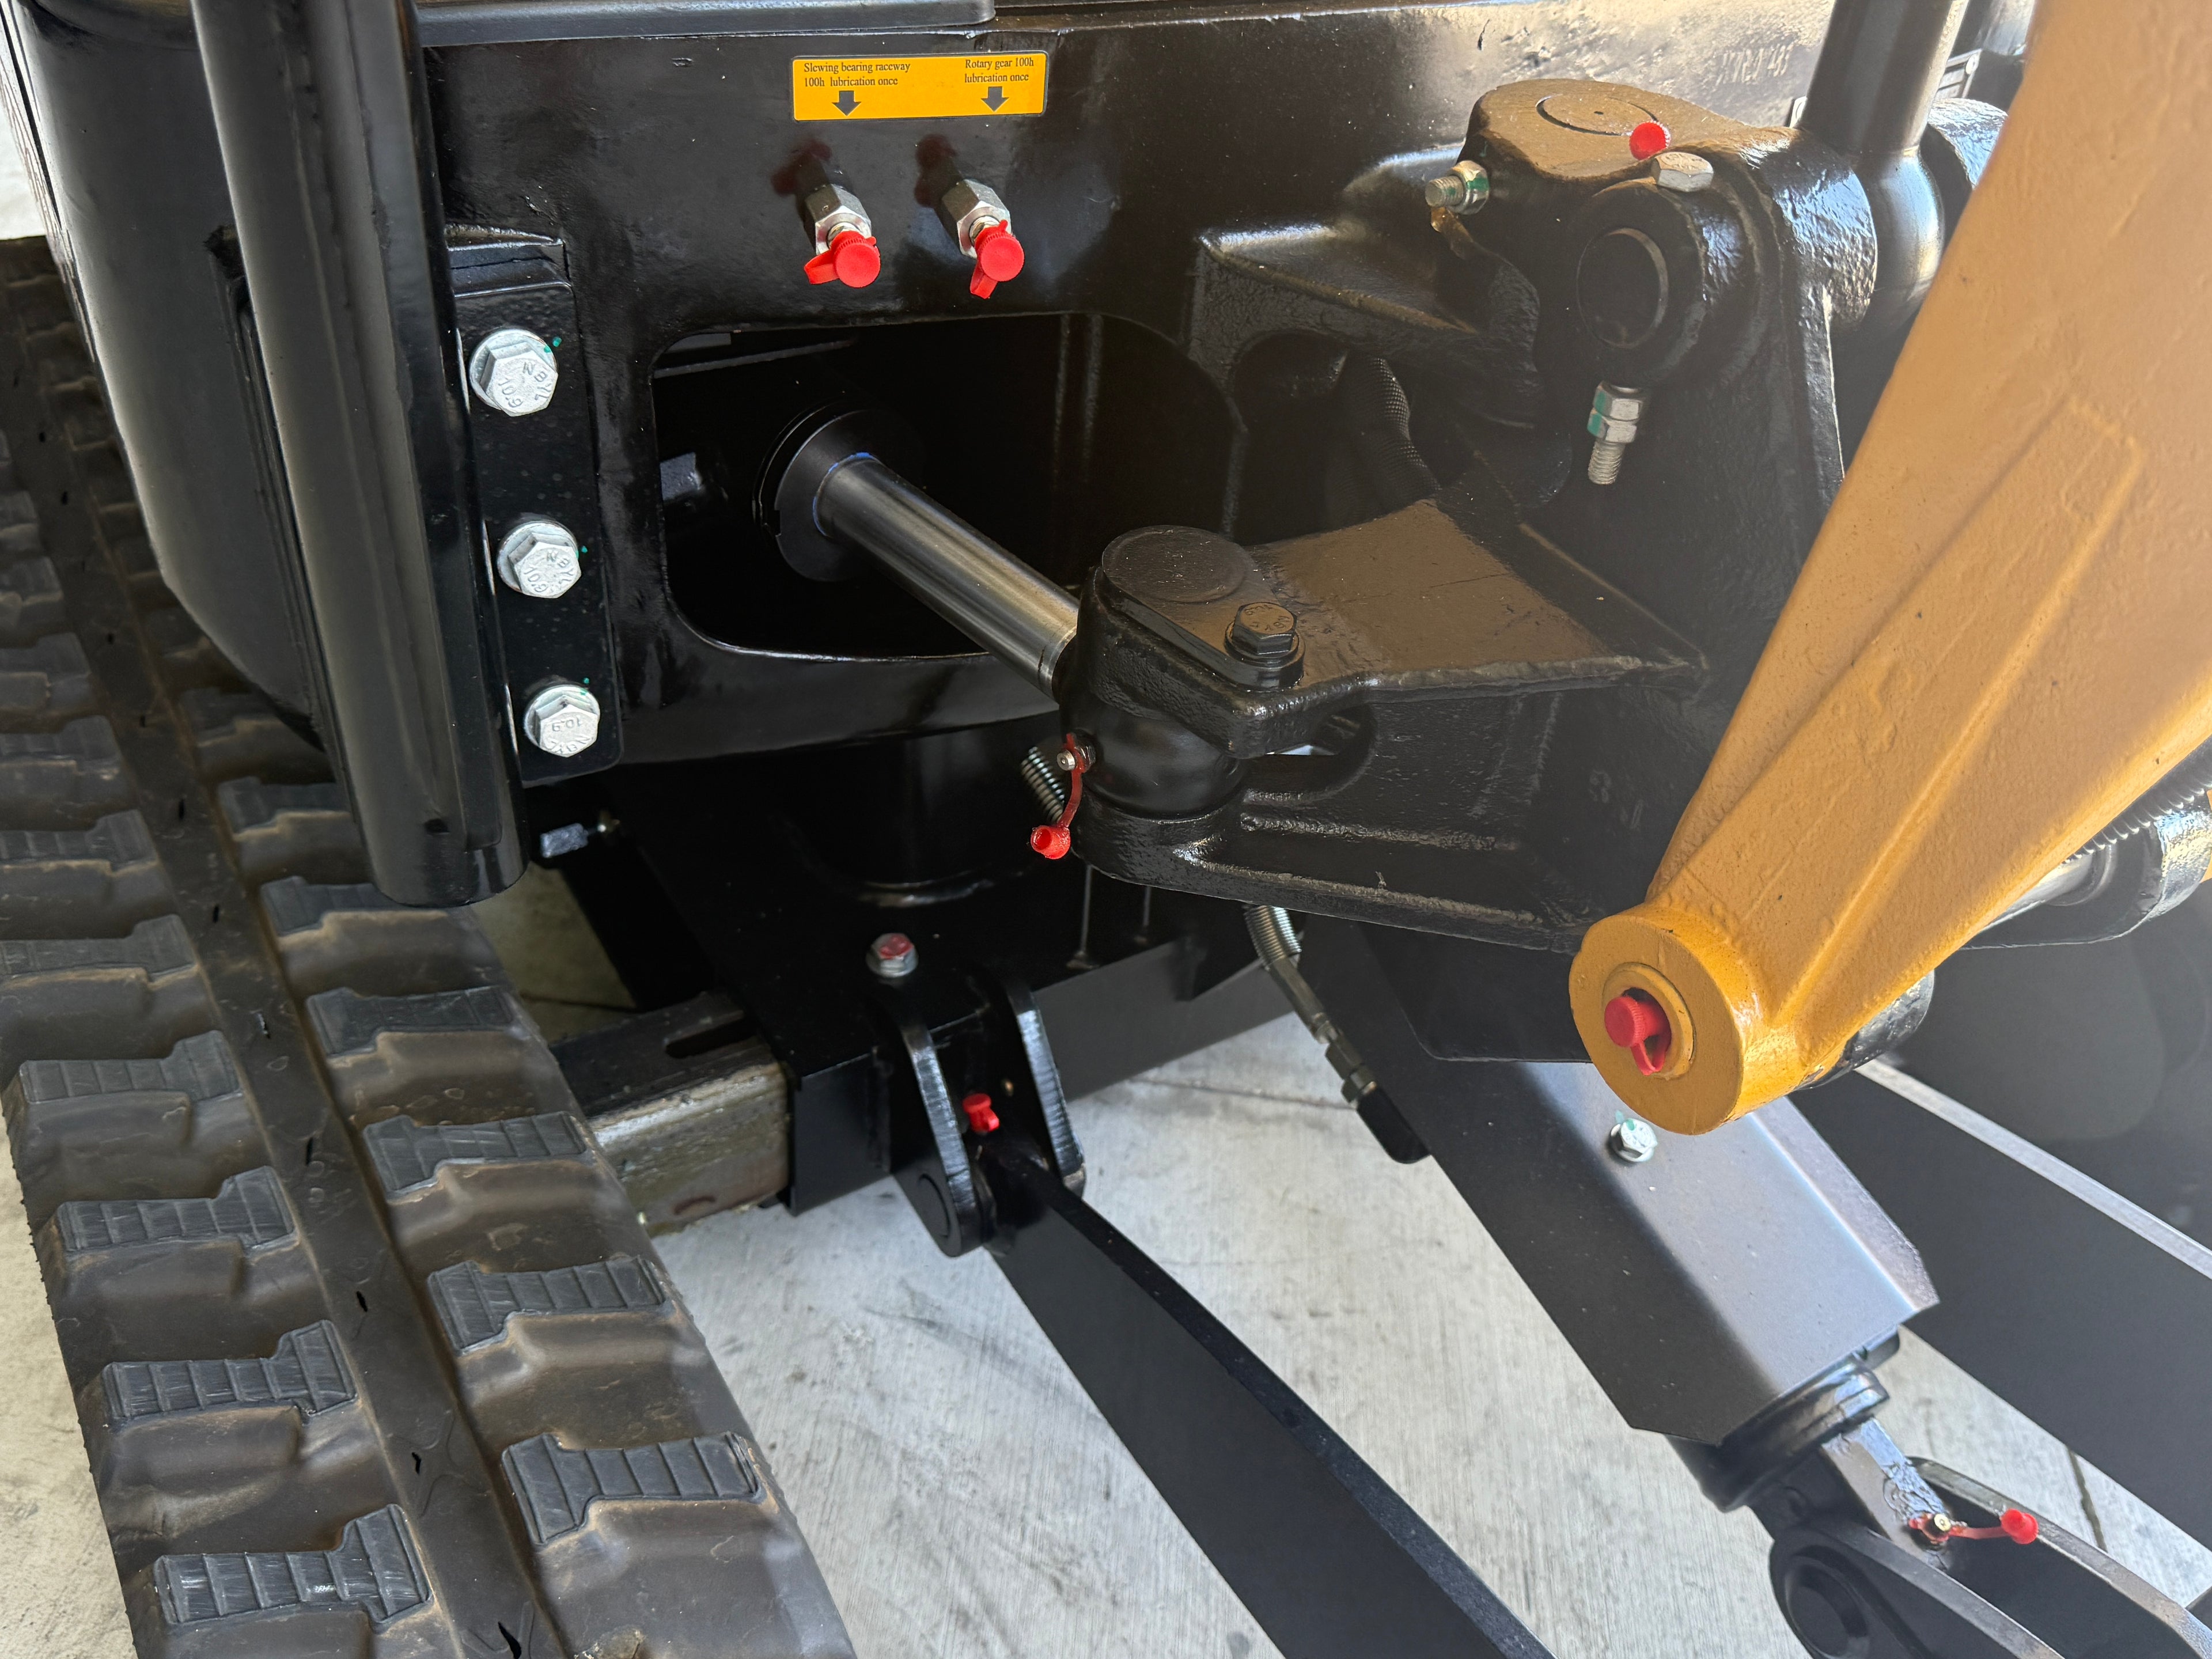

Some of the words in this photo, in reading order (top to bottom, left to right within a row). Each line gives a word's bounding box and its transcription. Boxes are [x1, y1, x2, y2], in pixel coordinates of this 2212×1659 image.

[804, 62, 838, 74] Slewing
[842, 62, 873, 73] bearing
[876, 63, 910, 73] raceway
[965, 59, 992, 70] Rotary
[995, 60, 1012, 70] gear
[1016, 57, 1033, 67] 100h
[805, 77, 825, 87] 100h
[830, 76, 875, 86] lubrication
[878, 77, 897, 85] once
[965, 73, 1007, 83] lubrication
